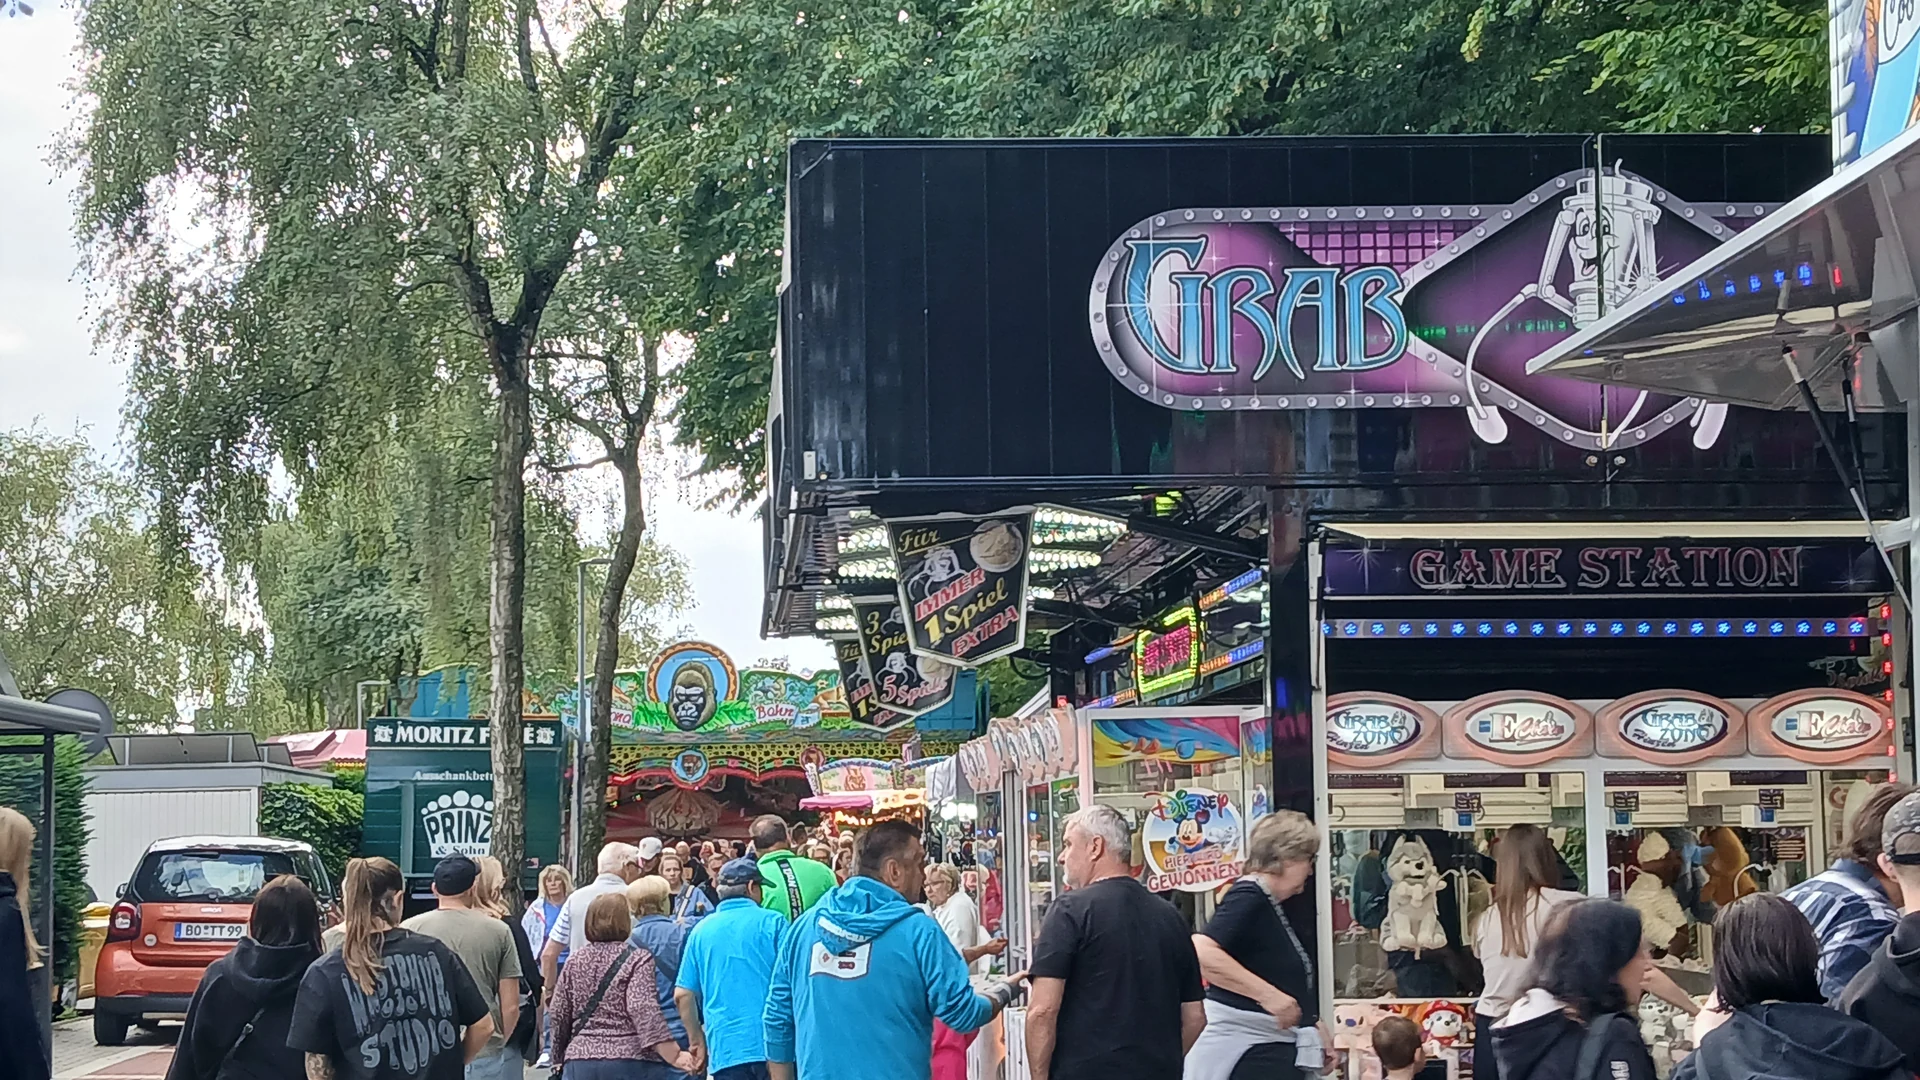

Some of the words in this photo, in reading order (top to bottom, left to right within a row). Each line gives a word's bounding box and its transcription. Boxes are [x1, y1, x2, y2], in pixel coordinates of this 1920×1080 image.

[1124, 235, 1408, 381] GRAB
[898, 527, 940, 552] Für
[1411, 548, 1567, 589] GAME
[1577, 545, 1803, 588] STATION
[915, 566, 986, 621] IMMER
[865, 611, 879, 634] 3
[924, 614, 942, 644] 1
[944, 577, 1009, 634] Spiel
[869, 630, 909, 654] Spie
[952, 605, 1019, 657] EXTRA
[880, 674, 898, 703] 5
[756, 704, 795, 720] Bahn
[395, 725, 475, 744] MORITZ
[426, 810, 493, 844] PRINZ
[435, 845, 447, 855] &
[453, 845, 485, 855] Sohn
[1164, 854, 1190, 868] HIER
[1148, 861, 1244, 890] GEWONNEN
[360, 1018, 456, 1075] STUDIO
